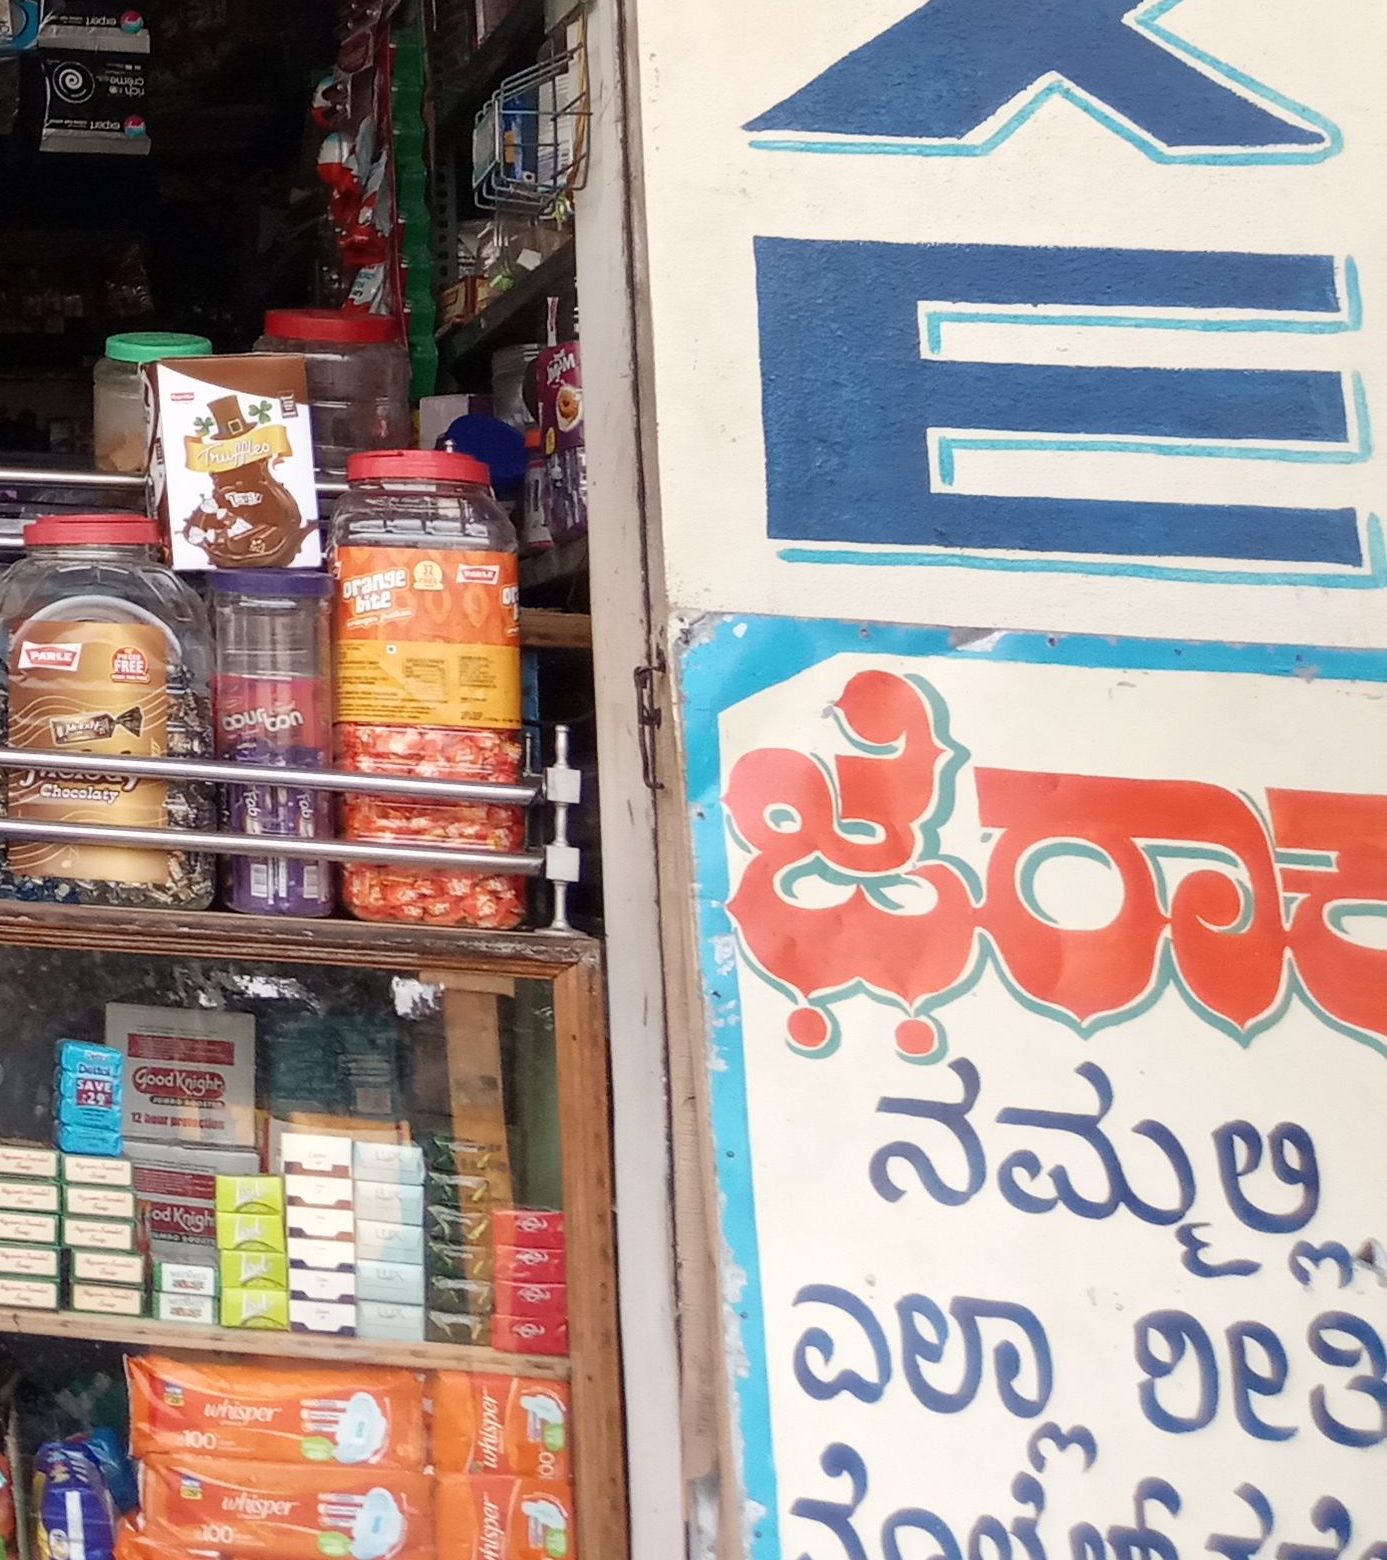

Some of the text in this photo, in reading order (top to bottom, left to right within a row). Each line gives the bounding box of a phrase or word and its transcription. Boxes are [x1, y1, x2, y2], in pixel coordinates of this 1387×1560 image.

[195, 438, 271, 466] Truffles
[343, 569, 407, 598] orange
[461, 569, 494, 581] PARLE
[354, 589, 392, 613] bite
[28, 649, 73, 664] PARLE
[113, 659, 145, 673] FREE
[39, 782, 120, 803] Chocolaty
[78, 1063, 111, 1077] Dettol
[76, 1079, 112, 1093] SAVE
[130, 1113, 225, 1129] 12 hour protection
[869, 1057, 1355, 1292] ನಮ್ಮಲ್ಲಿ
[792, 1283, 1099, 1473] ಎಲ್ಲಾ
[203, 1398, 283, 1425] whisper
[481, 1385, 501, 1470] whisper
[181, 1431, 218, 1451] 100
[221, 1493, 300, 1519] whisper
[201, 1525, 237, 1545] 100
